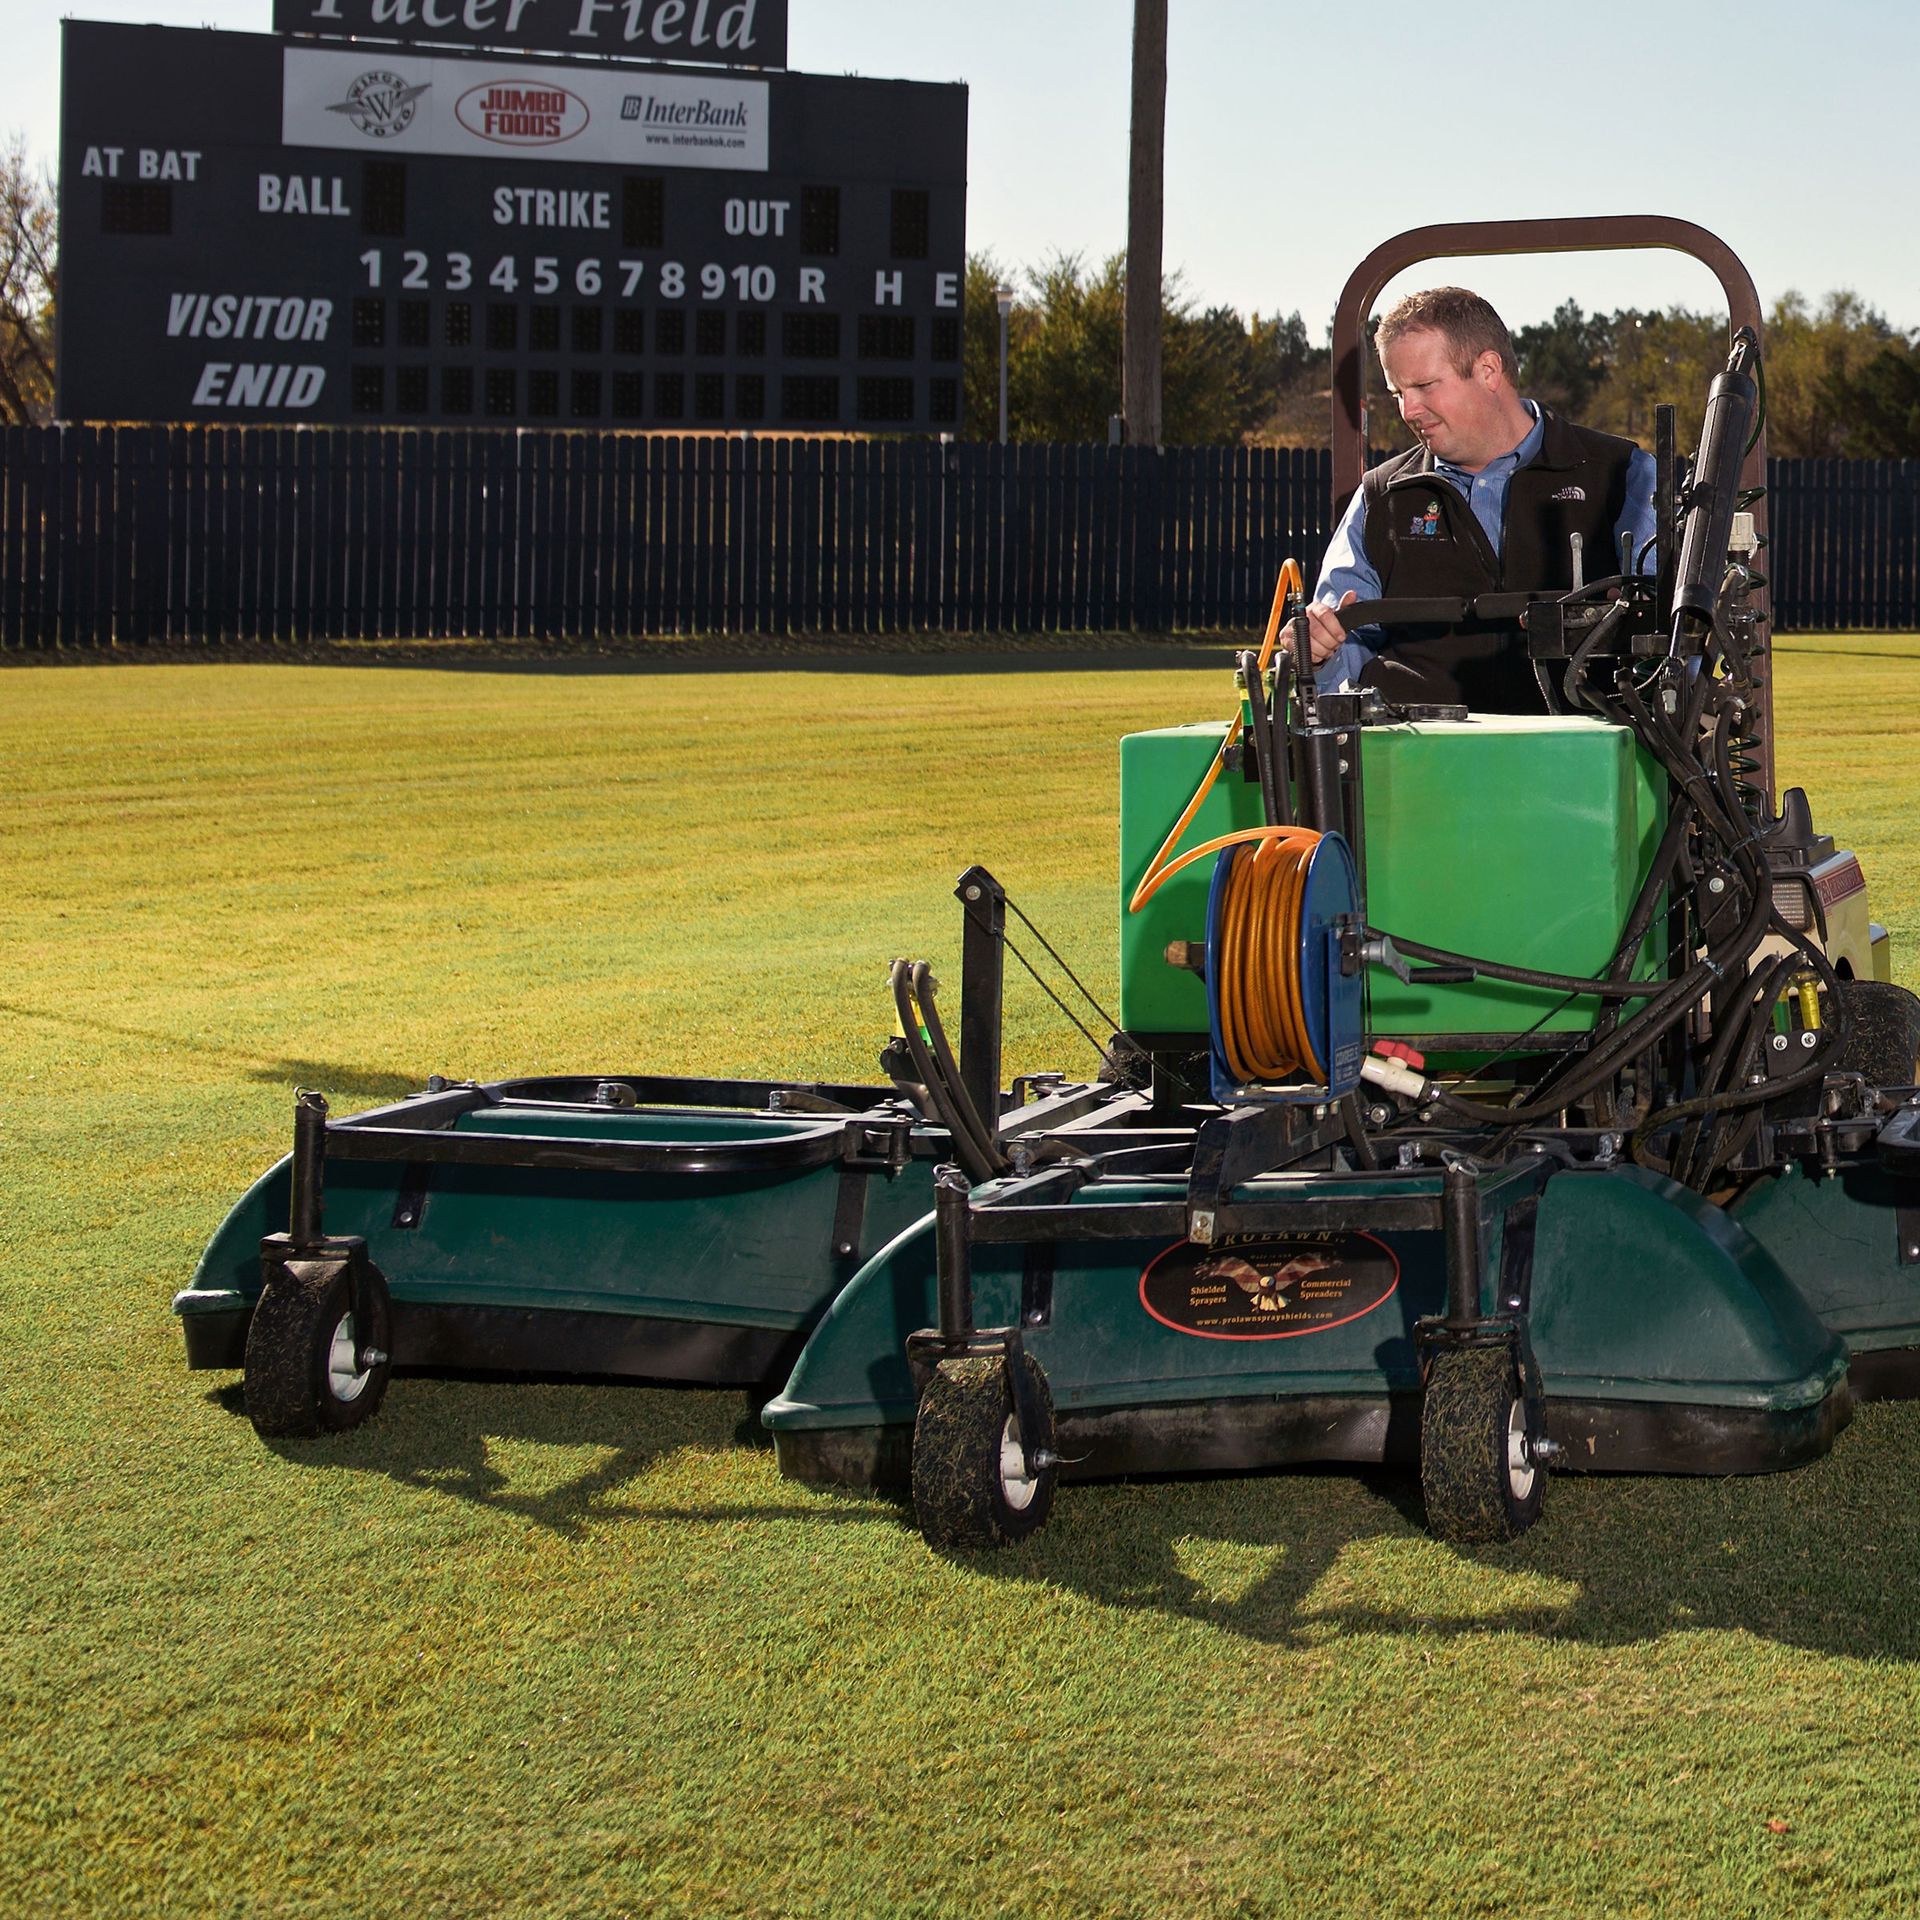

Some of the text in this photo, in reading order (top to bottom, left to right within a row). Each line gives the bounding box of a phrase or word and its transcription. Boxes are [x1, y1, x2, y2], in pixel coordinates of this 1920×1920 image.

[569, 0, 756, 50] Field
[350, 71, 403, 98] WINGS
[365, 89, 394, 121] W
[479, 88, 566, 115] JUMBO
[643, 96, 748, 127] InterBank
[362, 120, 386, 137] TO
[485, 112, 561, 137] FOODS
[82, 147, 202, 181] AT BAT
[258, 174, 350, 215] BALL
[493, 187, 610, 229] STRIKE
[725, 199, 790, 236] OUT
[360, 250, 381, 287] 1
[402, 251, 428, 289] 2
[446, 252, 472, 290] 3
[489, 256, 518, 292] 4
[534, 257, 559, 294] 5
[575, 259, 601, 295] 6
[619, 261, 643, 296] 7
[660, 262, 685, 298] 8
[799, 267, 825, 303] R
[875, 270, 902, 305] H
[935, 272, 958, 307] E
[167, 294, 333, 341] VISITOR
[192, 363, 326, 407] ENID
[1190, 1284, 1227, 1296] Shielded
[1300, 1290, 1343, 1300] Spreaders
[1301, 1279, 1351, 1289] Commercial
[1189, 1295, 1227, 1306] Sprayers
[1196, 1311, 1333, 1327] www.prolawnsprayshields.com
